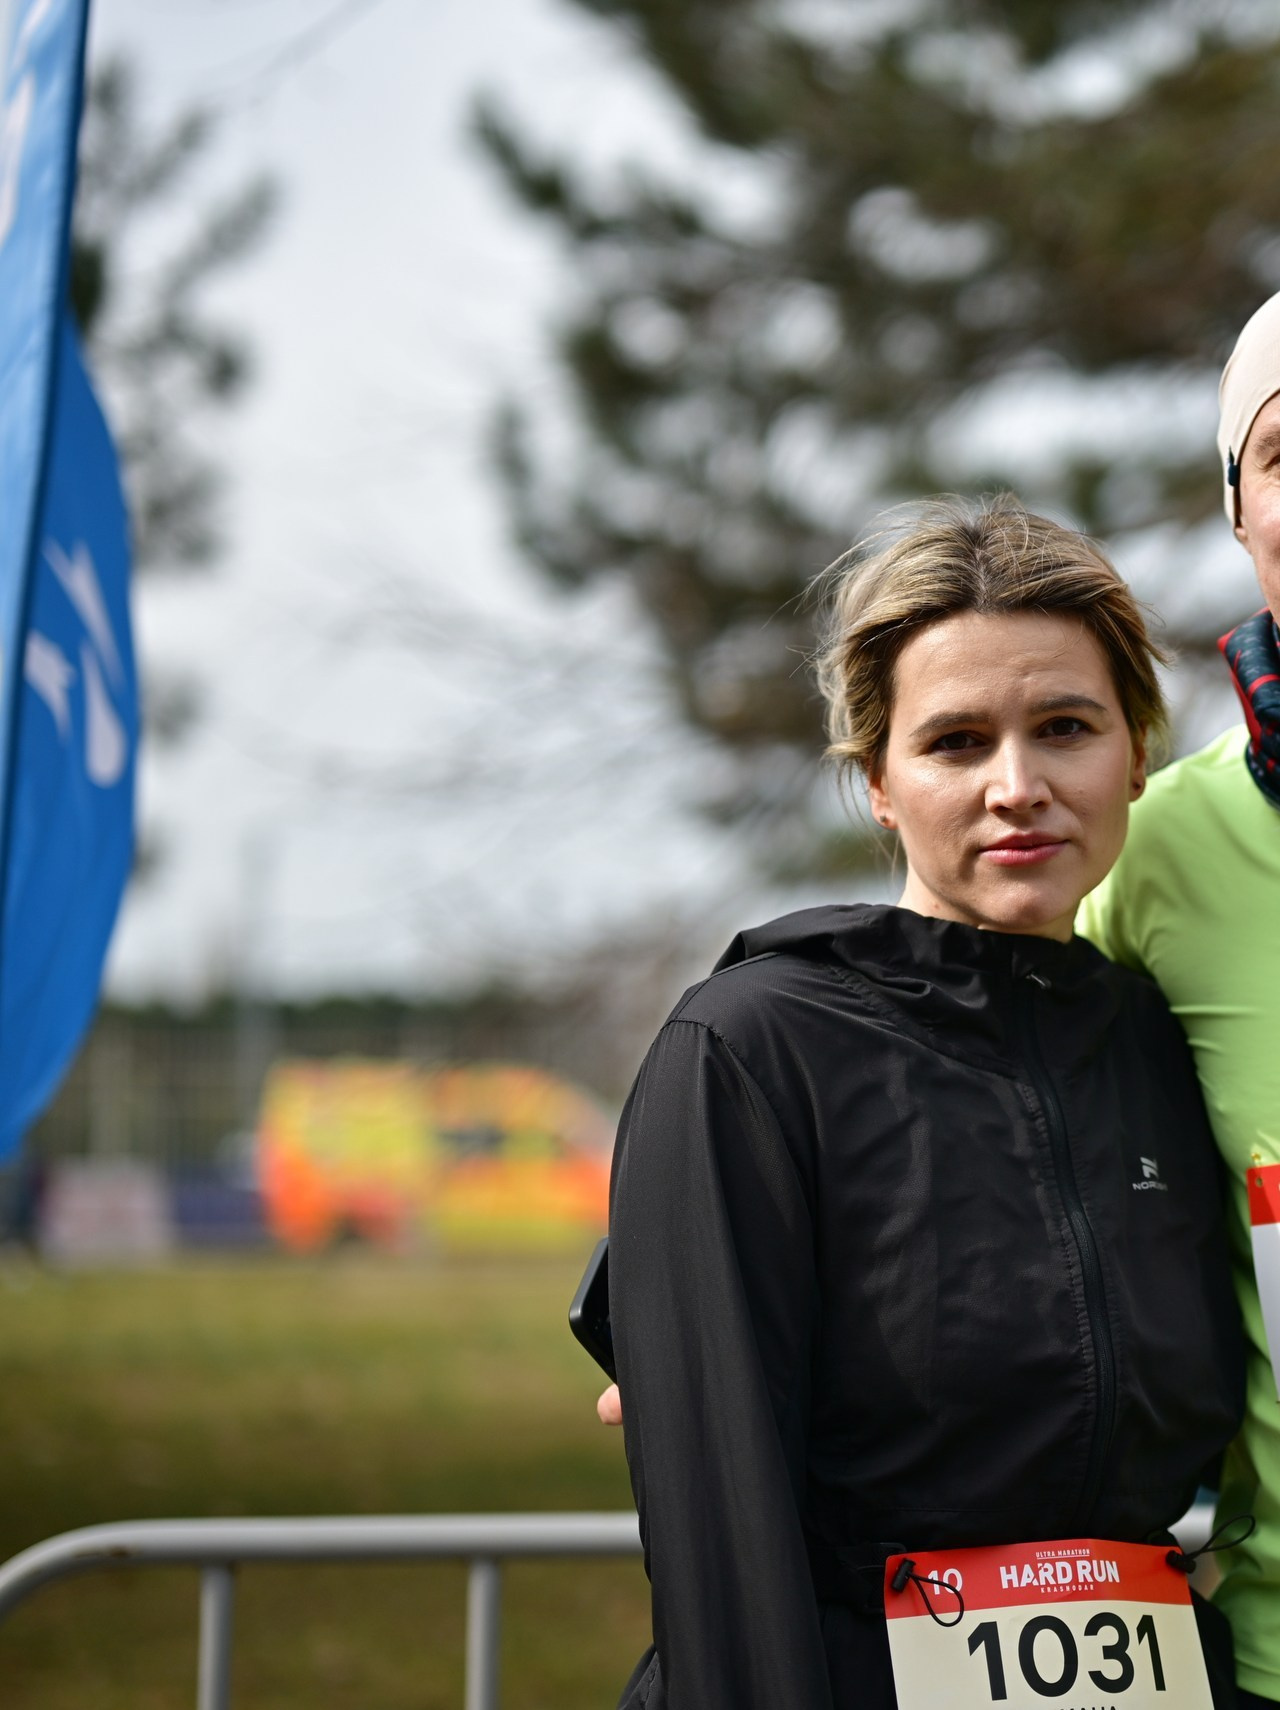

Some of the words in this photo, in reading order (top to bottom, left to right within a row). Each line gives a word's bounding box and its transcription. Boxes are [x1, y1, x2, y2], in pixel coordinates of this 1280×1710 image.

[1036, 1550, 1055, 1558] ULTRA
[1058, 1548, 1090, 1556] MARATHON
[927, 1568, 963, 1595] 10
[1000, 1560, 1073, 1589] HARD
[1076, 1560, 1120, 1583] RUN
[1040, 1584, 1094, 1594] KRASNODAR
[967, 1612, 1166, 1701] 1031
